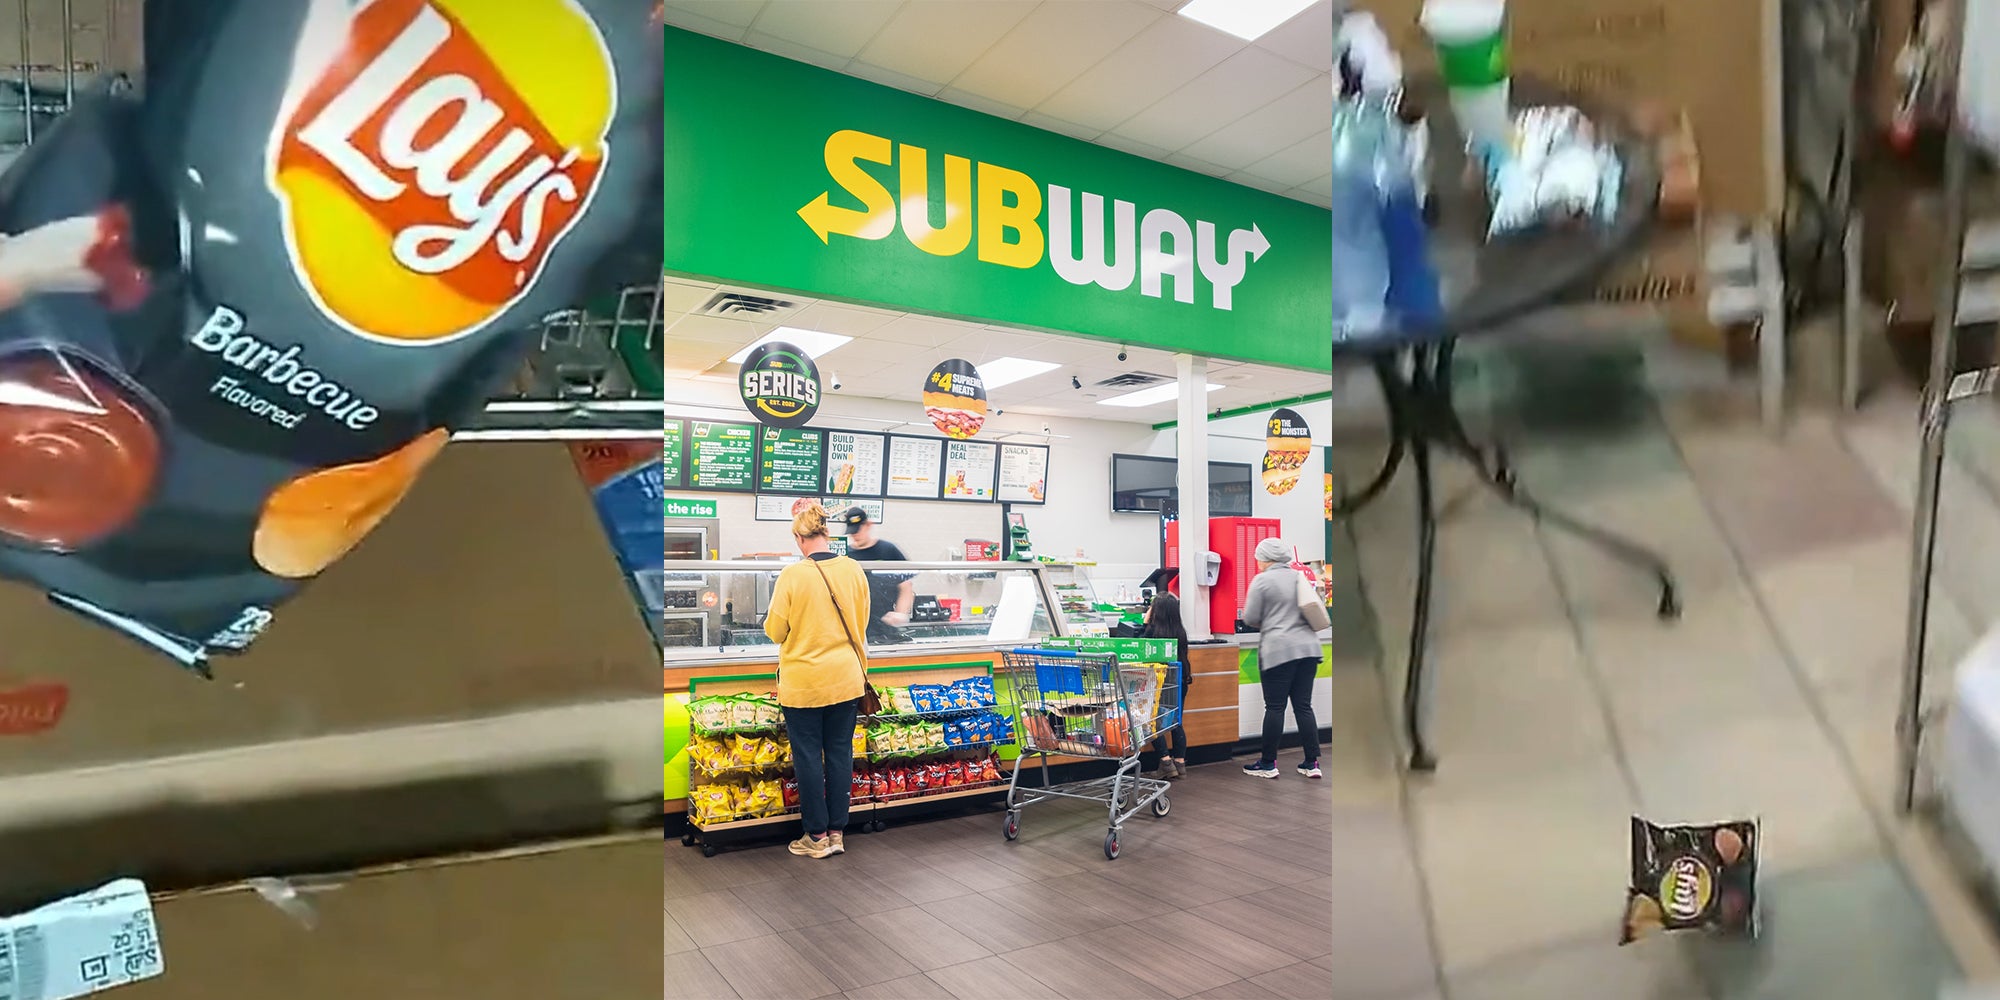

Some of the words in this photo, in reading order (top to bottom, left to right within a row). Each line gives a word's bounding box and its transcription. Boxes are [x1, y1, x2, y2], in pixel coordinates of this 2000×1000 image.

[297, 3, 581, 274] Lay's
[797, 129, 1271, 311] SUBWAY
[191, 305, 379, 429] Barbecue
[769, 360, 796, 369] SUBWAY
[931, 371, 953, 392] #4
[952, 373, 982, 389] SUPREME
[744, 369, 818, 405] SERIES
[951, 383, 975, 396] MEATS
[210, 375, 307, 429] Flavored
[1281, 419, 1292, 428] THE
[1281, 427, 1308, 436] MONSTER
[832, 434, 855, 443] BUILD
[832, 443, 854, 452] YOUR
[951, 444, 967, 452] MEAL
[1004, 446, 1029, 455] SNACKS
[950, 452, 967, 460] DEAL
[667, 502, 689, 515] the
[691, 503, 714, 516] rise
[1120, 652, 1139, 660] VIZIO
